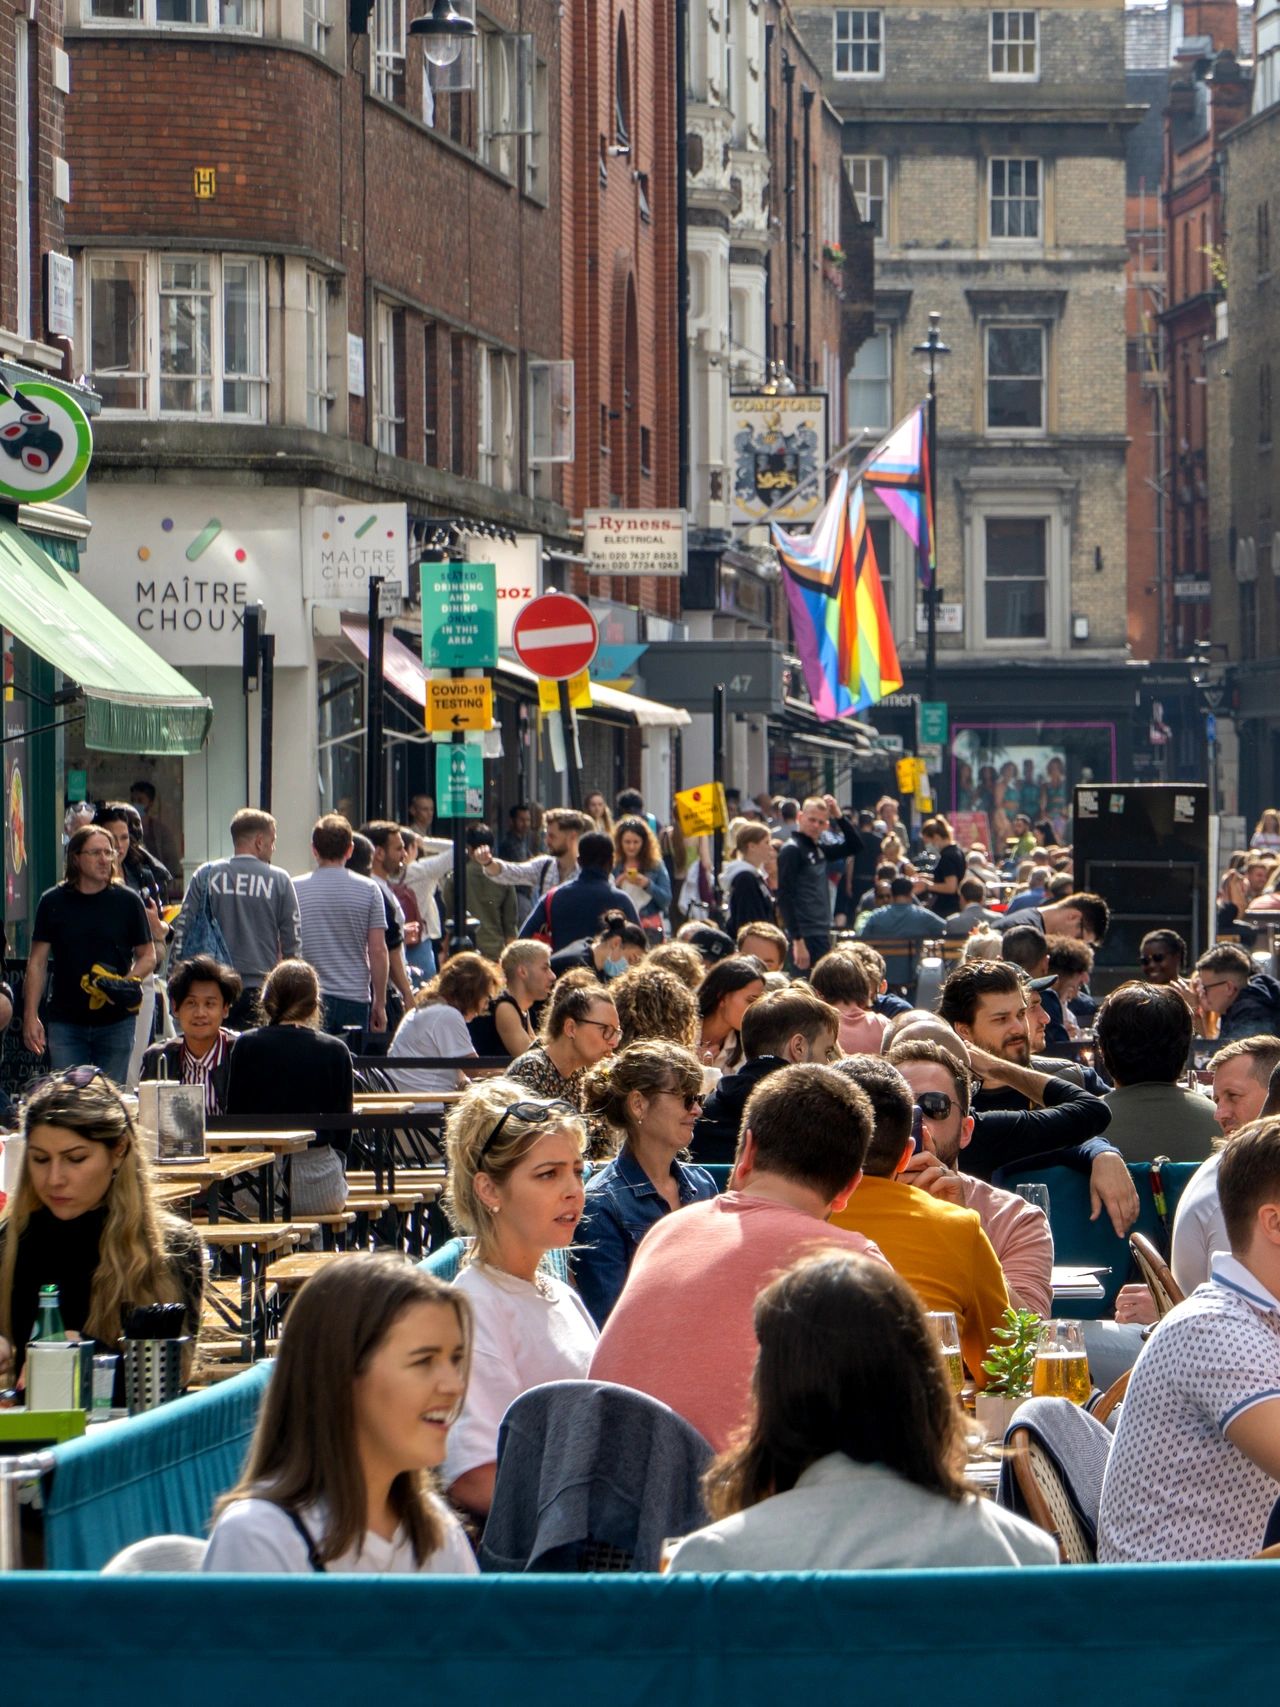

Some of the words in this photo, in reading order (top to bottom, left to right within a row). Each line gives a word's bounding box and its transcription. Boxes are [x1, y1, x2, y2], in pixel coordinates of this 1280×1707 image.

[731, 399, 821, 412] COMPTONS
[599, 515, 672, 534] Ryness
[603, 535, 665, 544] ELECTRICAL
[321, 545, 396, 564] MAÎTRE
[609, 551, 627, 560] 020
[612, 561, 630, 569] 020
[321, 564, 396, 580] CHOUX
[441, 571, 477, 580] SEATED
[137, 575, 247, 605] MAÎTRE
[433, 582, 484, 593] DRINKING
[449, 593, 470, 603] AND
[496, 588, 532, 599] aoz
[441, 604, 478, 614] DINING
[137, 607, 245, 632] CHOUX
[447, 614, 473, 624] ONLY
[442, 625, 453, 635] IN
[456, 625, 478, 634] THIS
[447, 636, 473, 645] AREA
[730, 675, 752, 693] 47
[431, 684, 485, 696] COVID-19
[434, 700, 484, 710] TESTING
[208, 871, 274, 900] KLEIN
